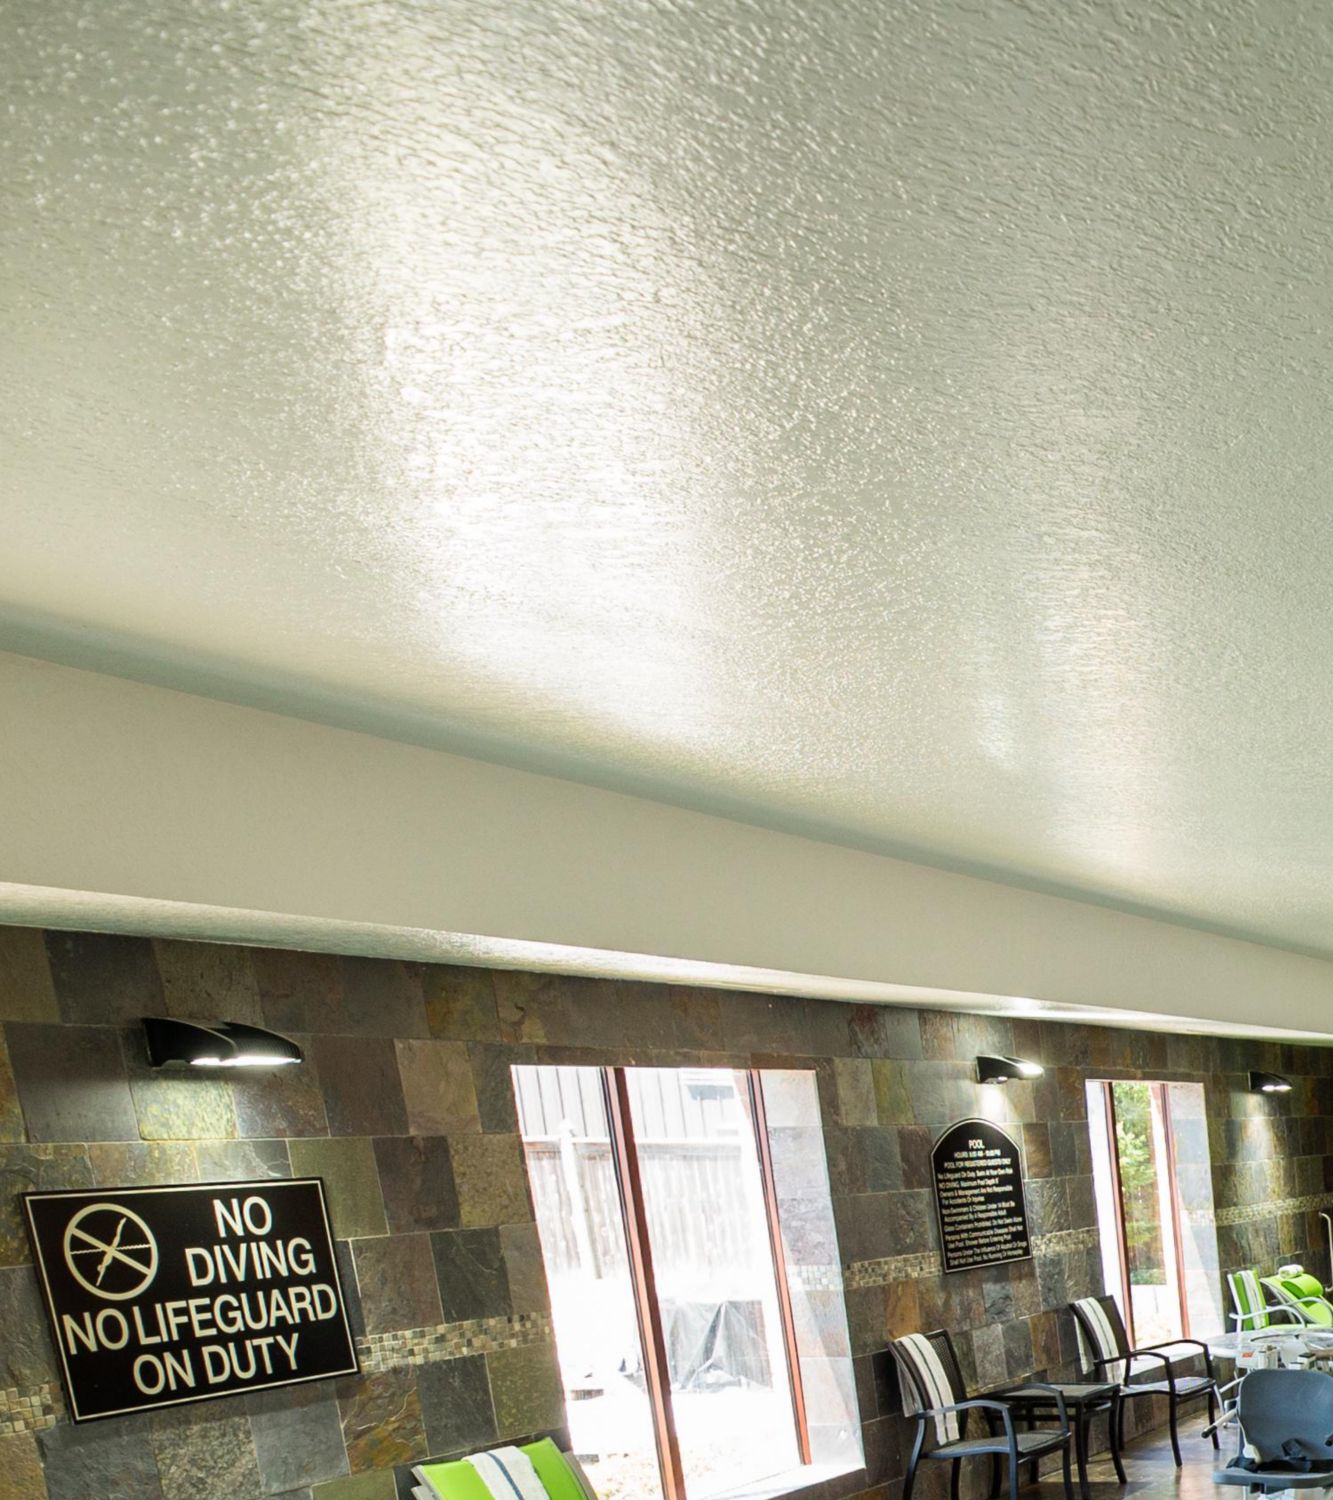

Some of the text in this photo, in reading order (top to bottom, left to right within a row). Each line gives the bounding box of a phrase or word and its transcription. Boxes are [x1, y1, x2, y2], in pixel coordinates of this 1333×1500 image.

[968, 1139, 984, 1148] POOL
[213, 1196, 273, 1238] NO
[184, 1237, 317, 1287] DIVING
[62, 1283, 338, 1355] NO LIFEGUARD
[133, 1332, 299, 1395] ON DUTY
